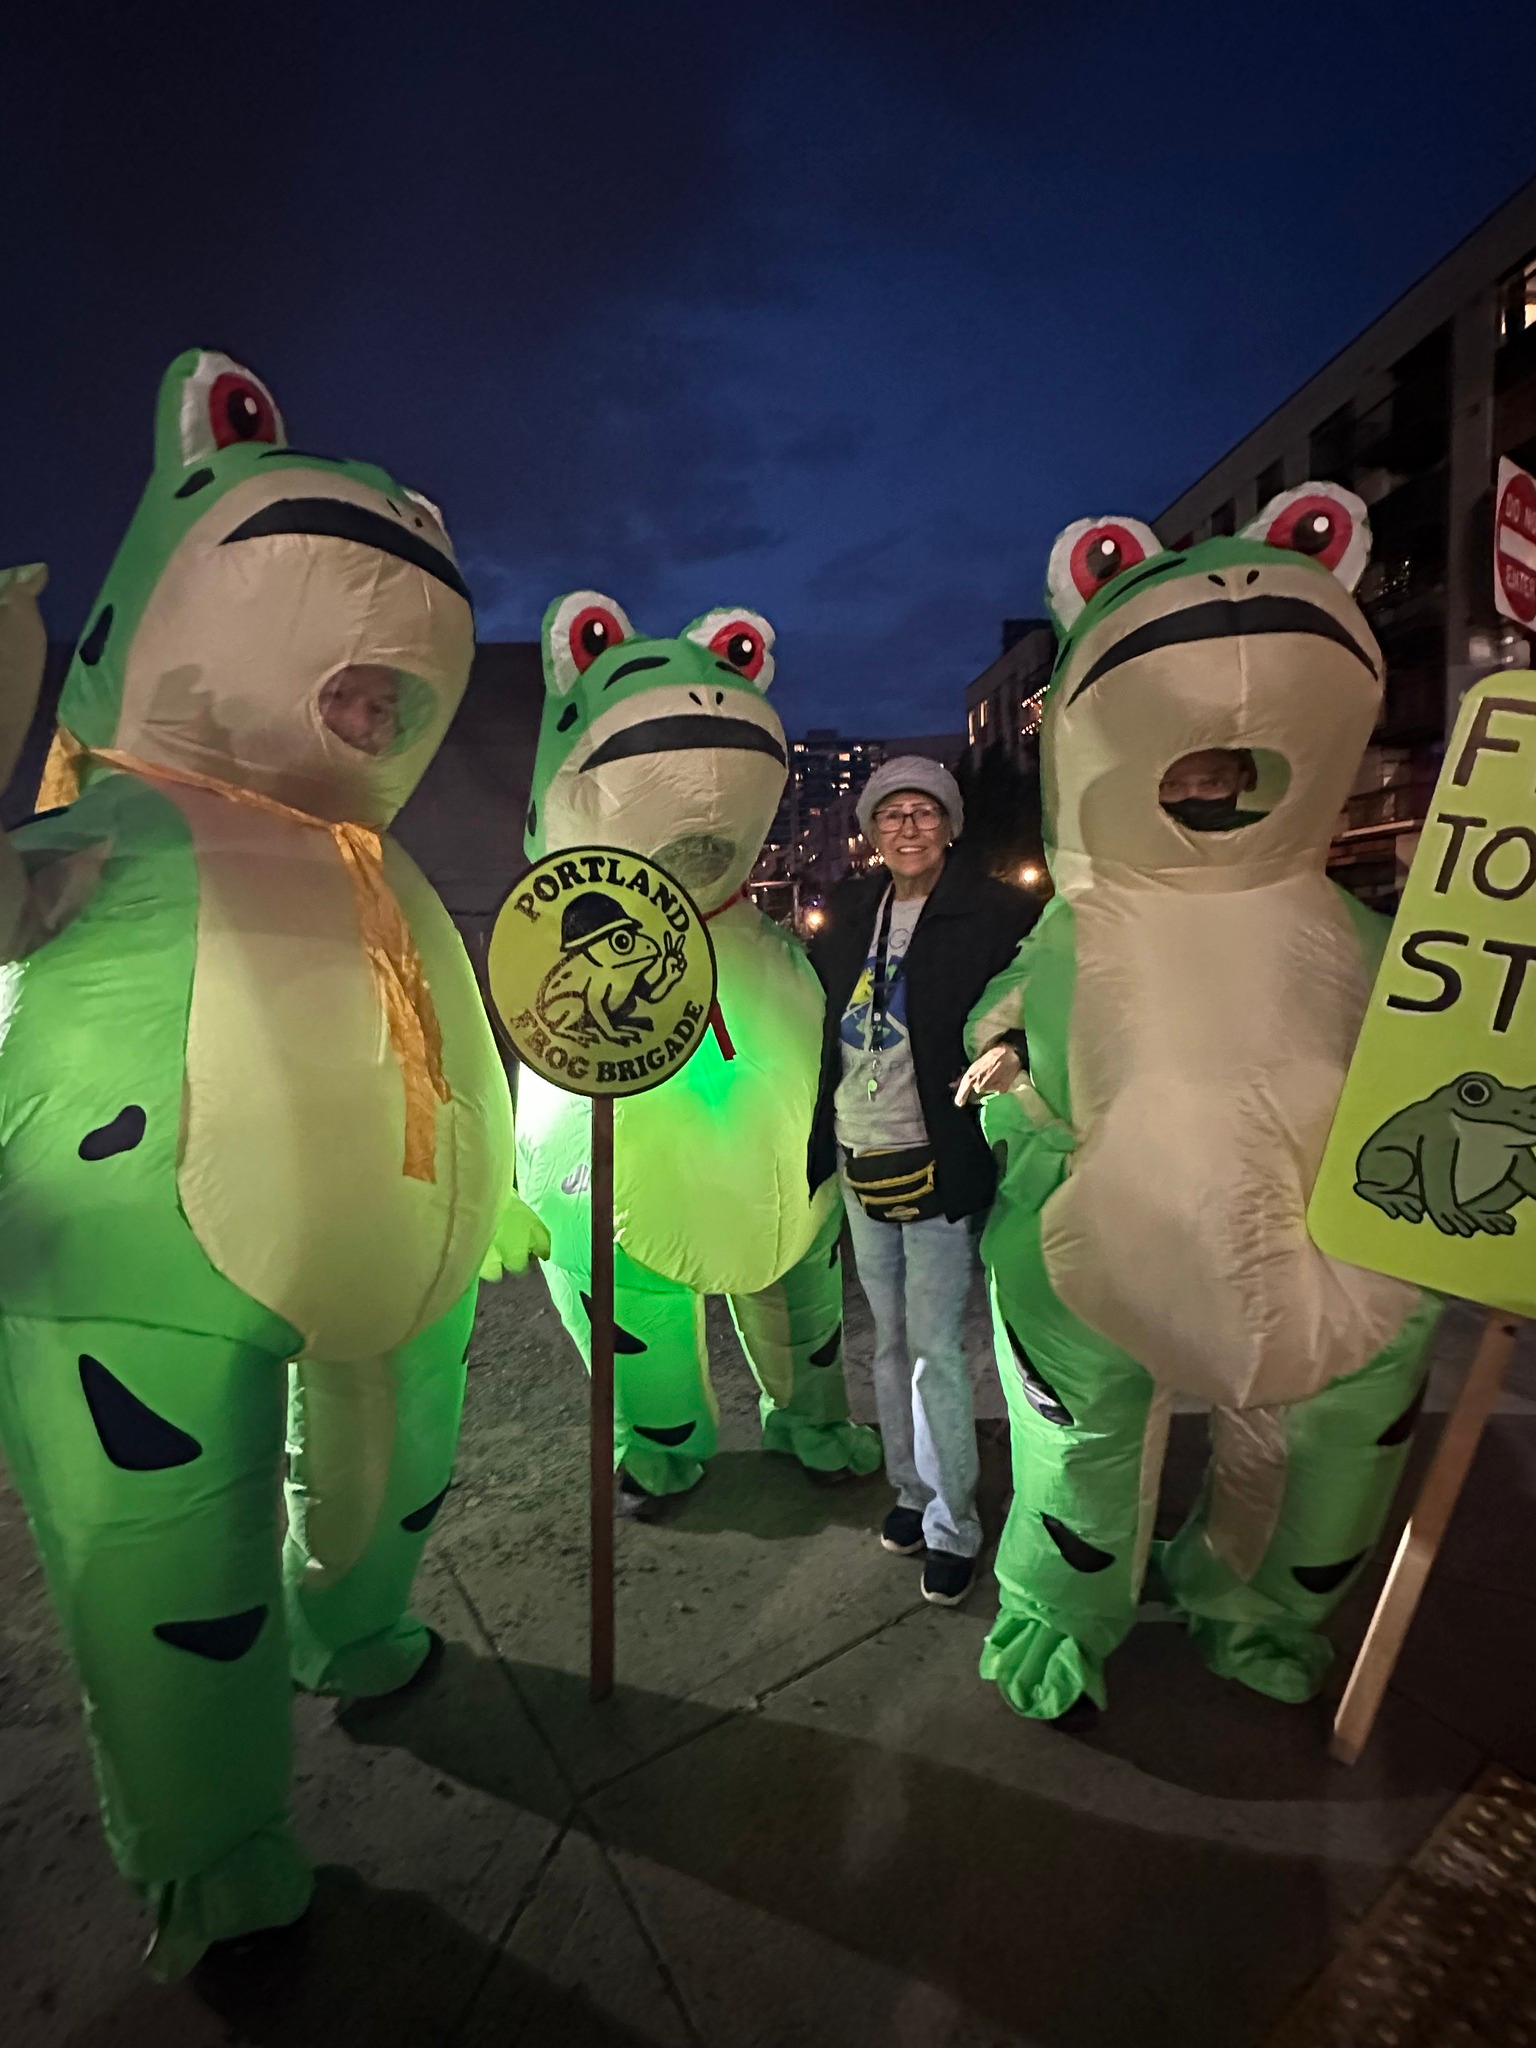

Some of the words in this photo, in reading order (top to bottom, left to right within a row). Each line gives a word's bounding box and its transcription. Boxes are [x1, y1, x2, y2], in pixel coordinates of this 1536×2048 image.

[1452, 697, 1536, 793] F
[513, 855, 690, 933] PORTLAND
[510, 1008, 591, 1080] FROG
[595, 1000, 704, 1083] BRIGADE
